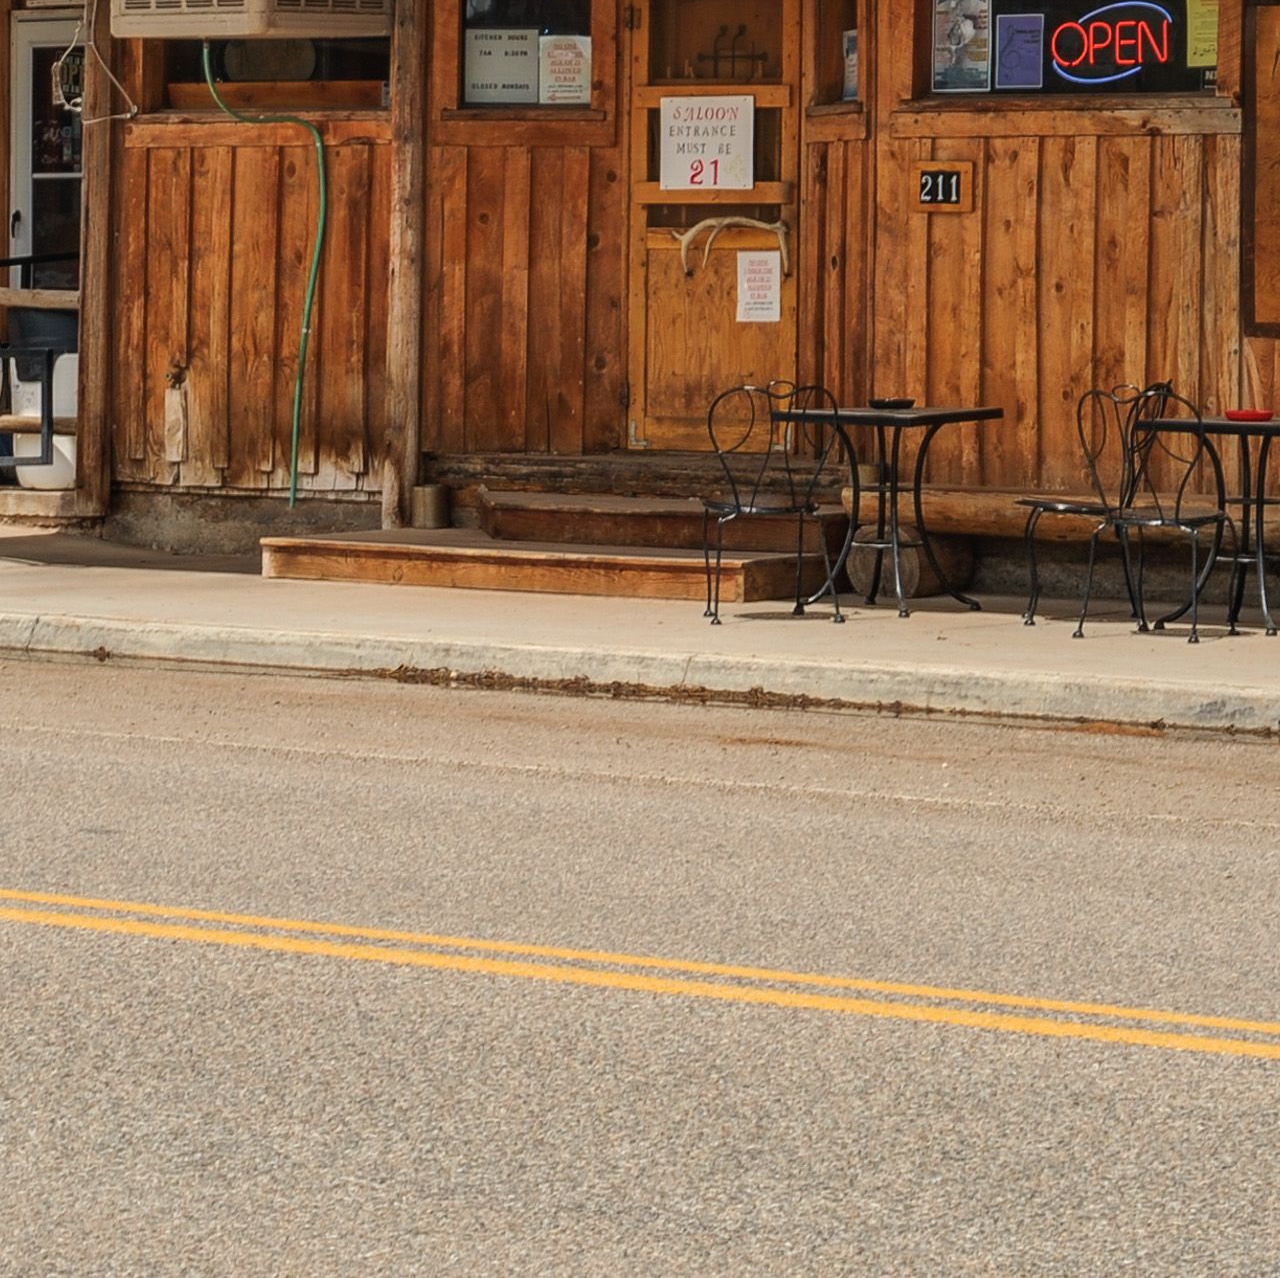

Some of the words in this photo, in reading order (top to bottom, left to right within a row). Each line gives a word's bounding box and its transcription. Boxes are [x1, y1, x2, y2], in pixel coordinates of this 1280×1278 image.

[1051, 20, 1170, 67] OPEN
[673, 106, 739, 122] SALOON
[669, 125, 736, 137] ENTRANCE
[676, 143, 706, 154] MUST
[718, 143, 732, 154] BE
[690, 159, 719, 185] 21
[920, 174, 958, 202] 211
